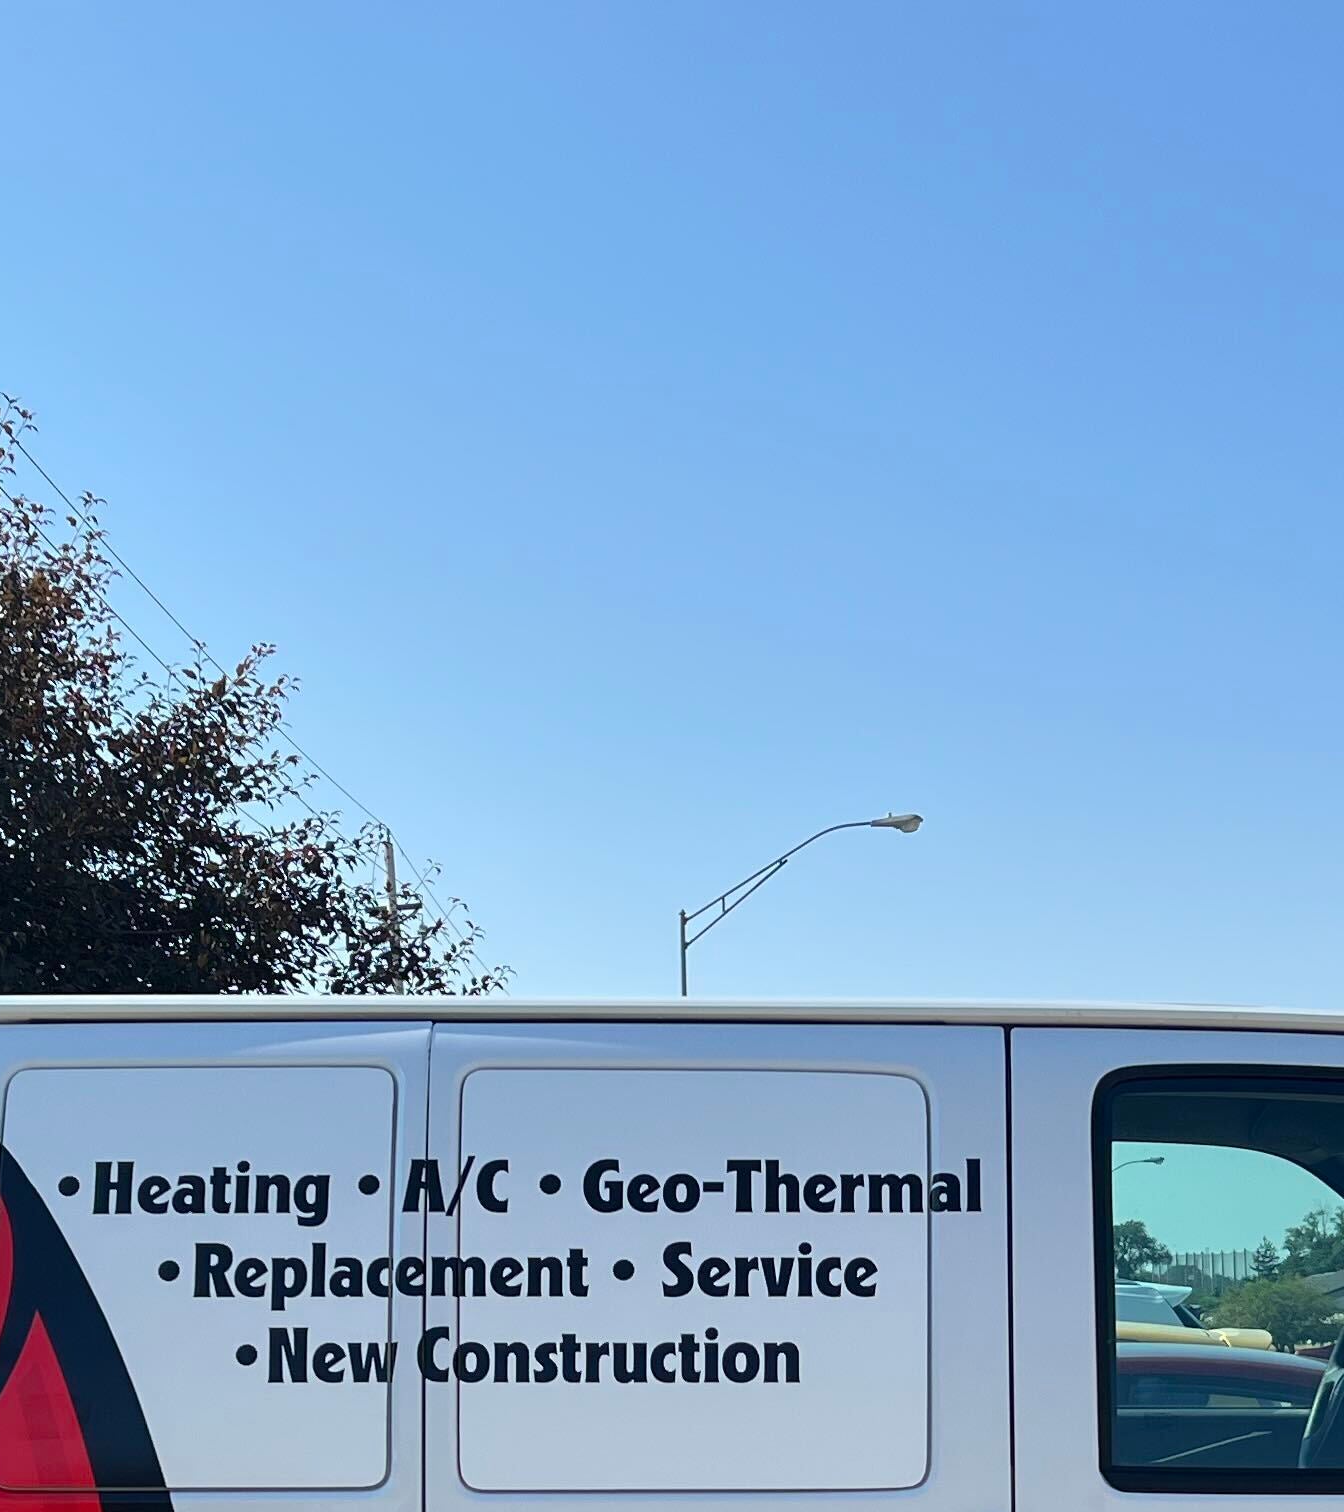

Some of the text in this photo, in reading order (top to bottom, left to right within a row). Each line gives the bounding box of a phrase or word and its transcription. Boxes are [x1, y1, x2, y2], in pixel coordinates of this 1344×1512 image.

[92, 1155, 983, 1228] Heating A/C Geo-Thermal
[193, 1241, 879, 1311] Replacement Service
[267, 1326, 801, 1385] New Construction
